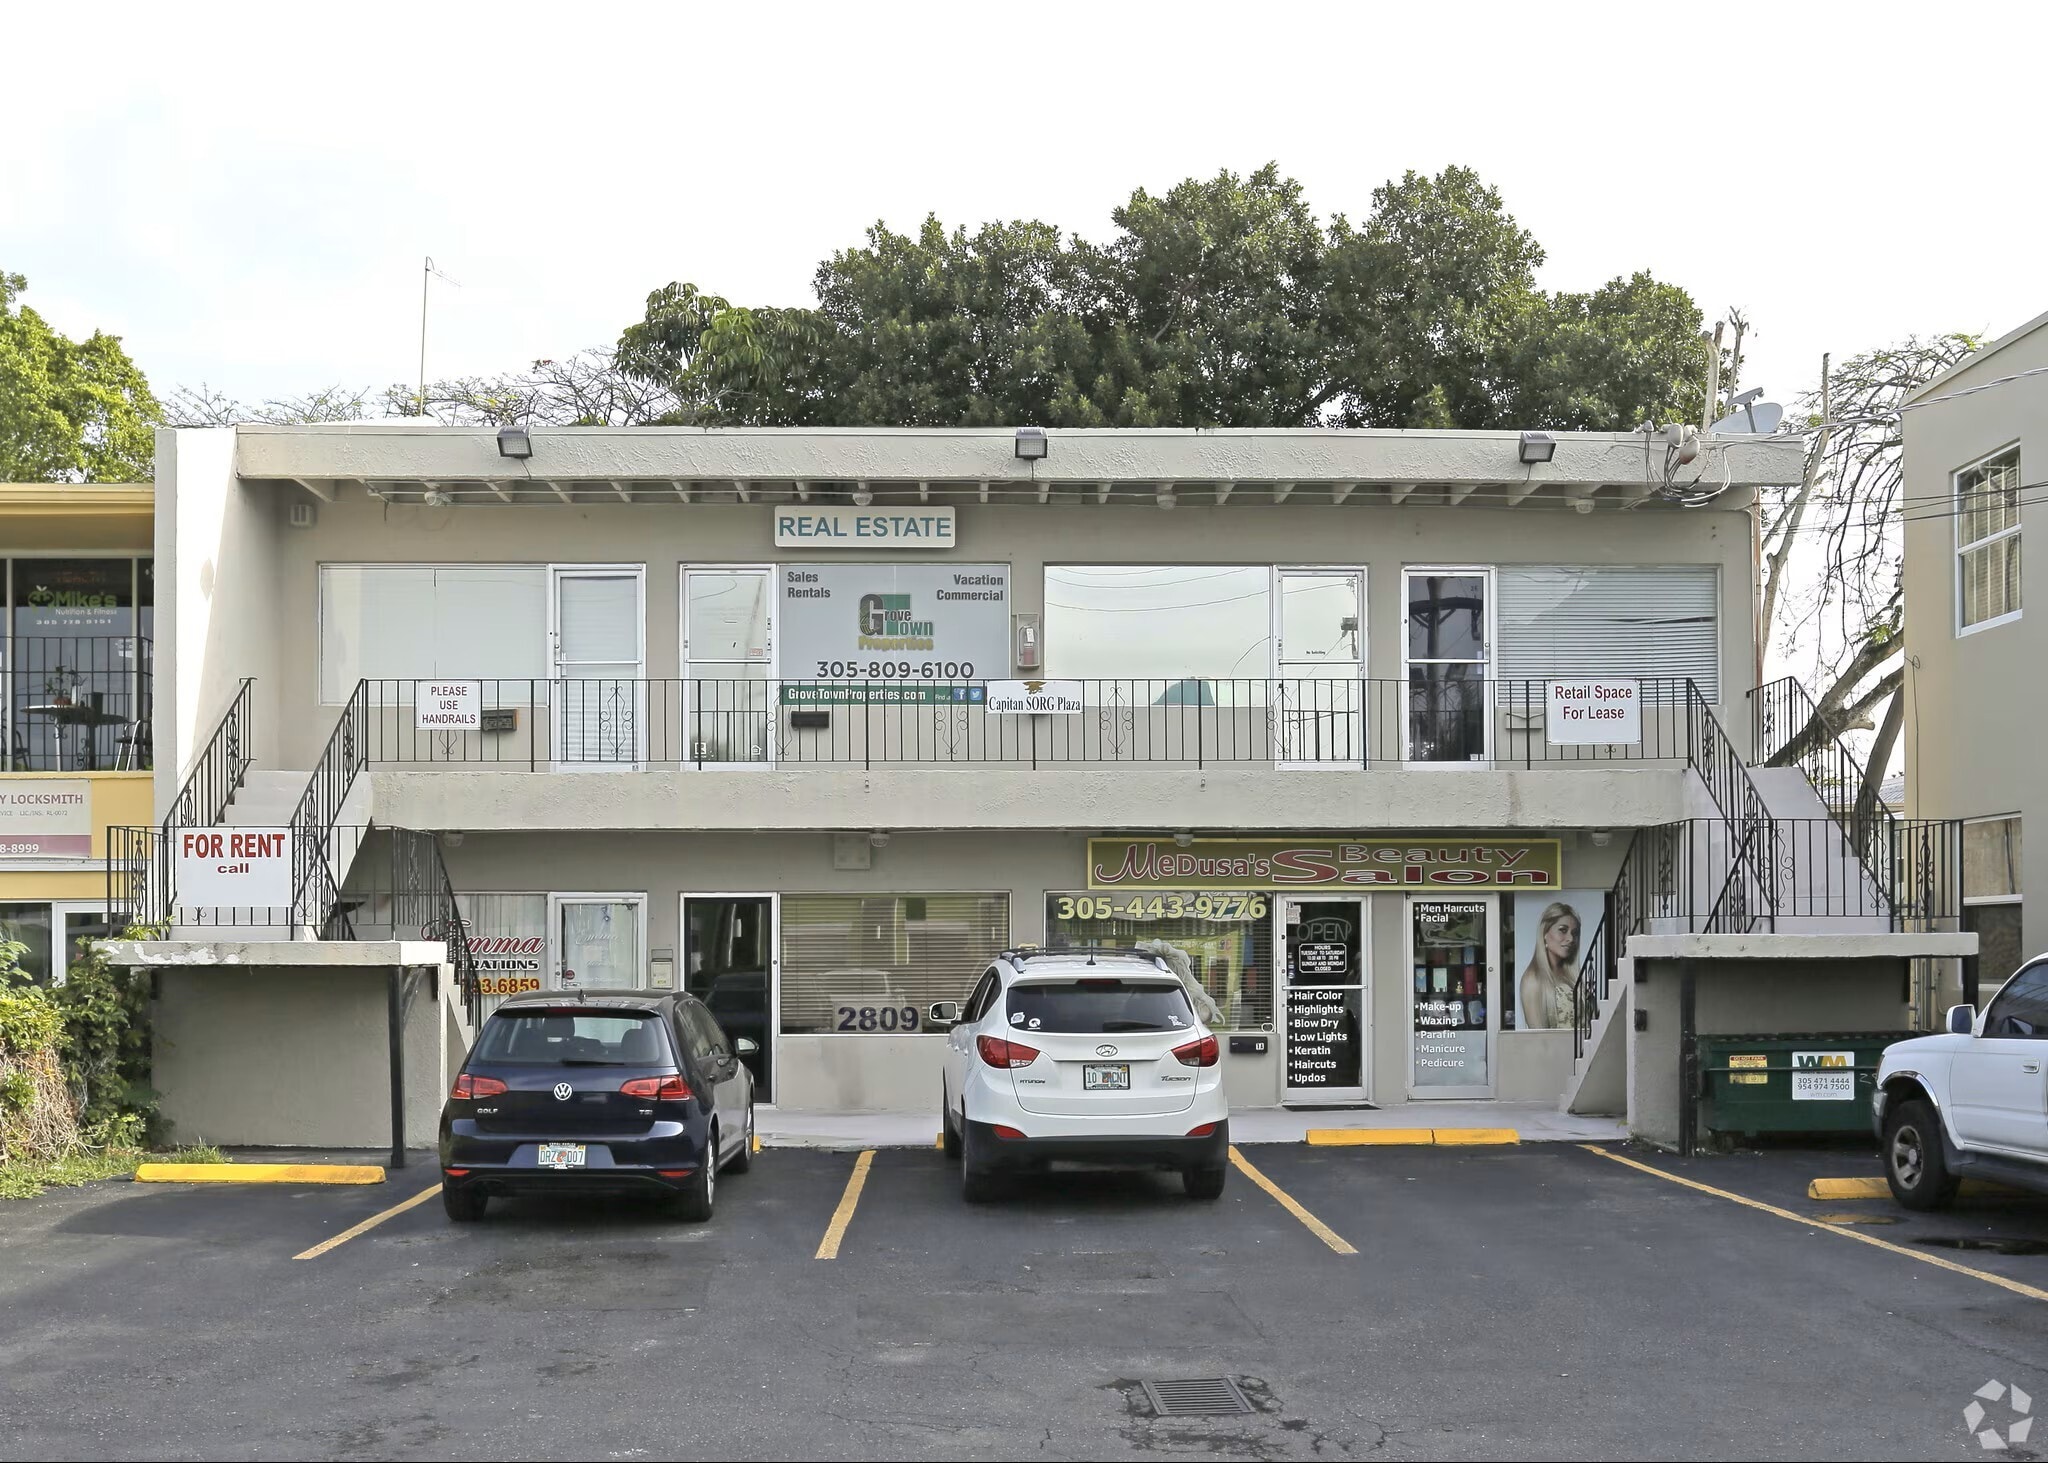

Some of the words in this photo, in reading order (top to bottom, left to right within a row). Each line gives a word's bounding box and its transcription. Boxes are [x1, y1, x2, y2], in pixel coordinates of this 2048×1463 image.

[779, 517, 847, 537] REAL
[856, 517, 952, 537] ESTATE
[787, 571, 819, 583] Sales
[953, 574, 1004, 586] Vacation
[787, 587, 831, 599] Rentals
[936, 589, 1004, 601] Commercial
[858, 636, 935, 651] Properties
[816, 661, 975, 679] 305-809-6100
[430, 686, 468, 696] PLEASE
[1555, 685, 1591, 700] Retail
[1594, 685, 1633, 702] Space
[439, 700, 459, 710] USE
[988, 696, 1024, 713] Capitan
[1026, 696, 1055, 711] SORG
[1057, 696, 1081, 711] Plaza
[422, 714, 476, 724] HANDRAILS
[1563, 706, 1585, 720] For
[1588, 706, 1625, 720] Lease
[11, 794, 83, 804] LOCKSMITH
[183, 833, 224, 858] FOR
[230, 833, 286, 858] RENT
[1338, 844, 1530, 868] Beauty
[217, 862, 249, 874] call
[1271, 849, 1550, 884] Salon
[1057, 895, 1268, 920] 305-443-9776
[1420, 904, 1441, 913] Men
[1443, 903, 1485, 913] Haircuts
[1420, 913, 1449, 923] Facial
[1297, 922, 1349, 941] OPEN
[473, 959, 539, 971] RATIONS
[472, 978, 540, 995] 3.6859
[1294, 991, 1314, 1000] Hair
[1315, 991, 1343, 1000] Color
[1294, 1004, 1344, 1015] Highlights
[1420, 1002, 1462, 1013] Make-up
[837, 1006, 919, 1032] 2809
[1294, 1019, 1319, 1028] Blow
[1320, 1018, 1339, 1029] Dry
[1420, 1016, 1458, 1026] Waxing
[1294, 1032, 1316, 1042] Low
[1317, 1032, 1348, 1043] Lights
[1420, 1030, 1456, 1040] Parafin
[1294, 1045, 1331, 1055] Keratin
[1421, 1044, 1466, 1053] Manicure
[1294, 1060, 1337, 1069] Haircuts
[1421, 1058, 1465, 1068] Pedicure
[1294, 1073, 1326, 1084] Updos
